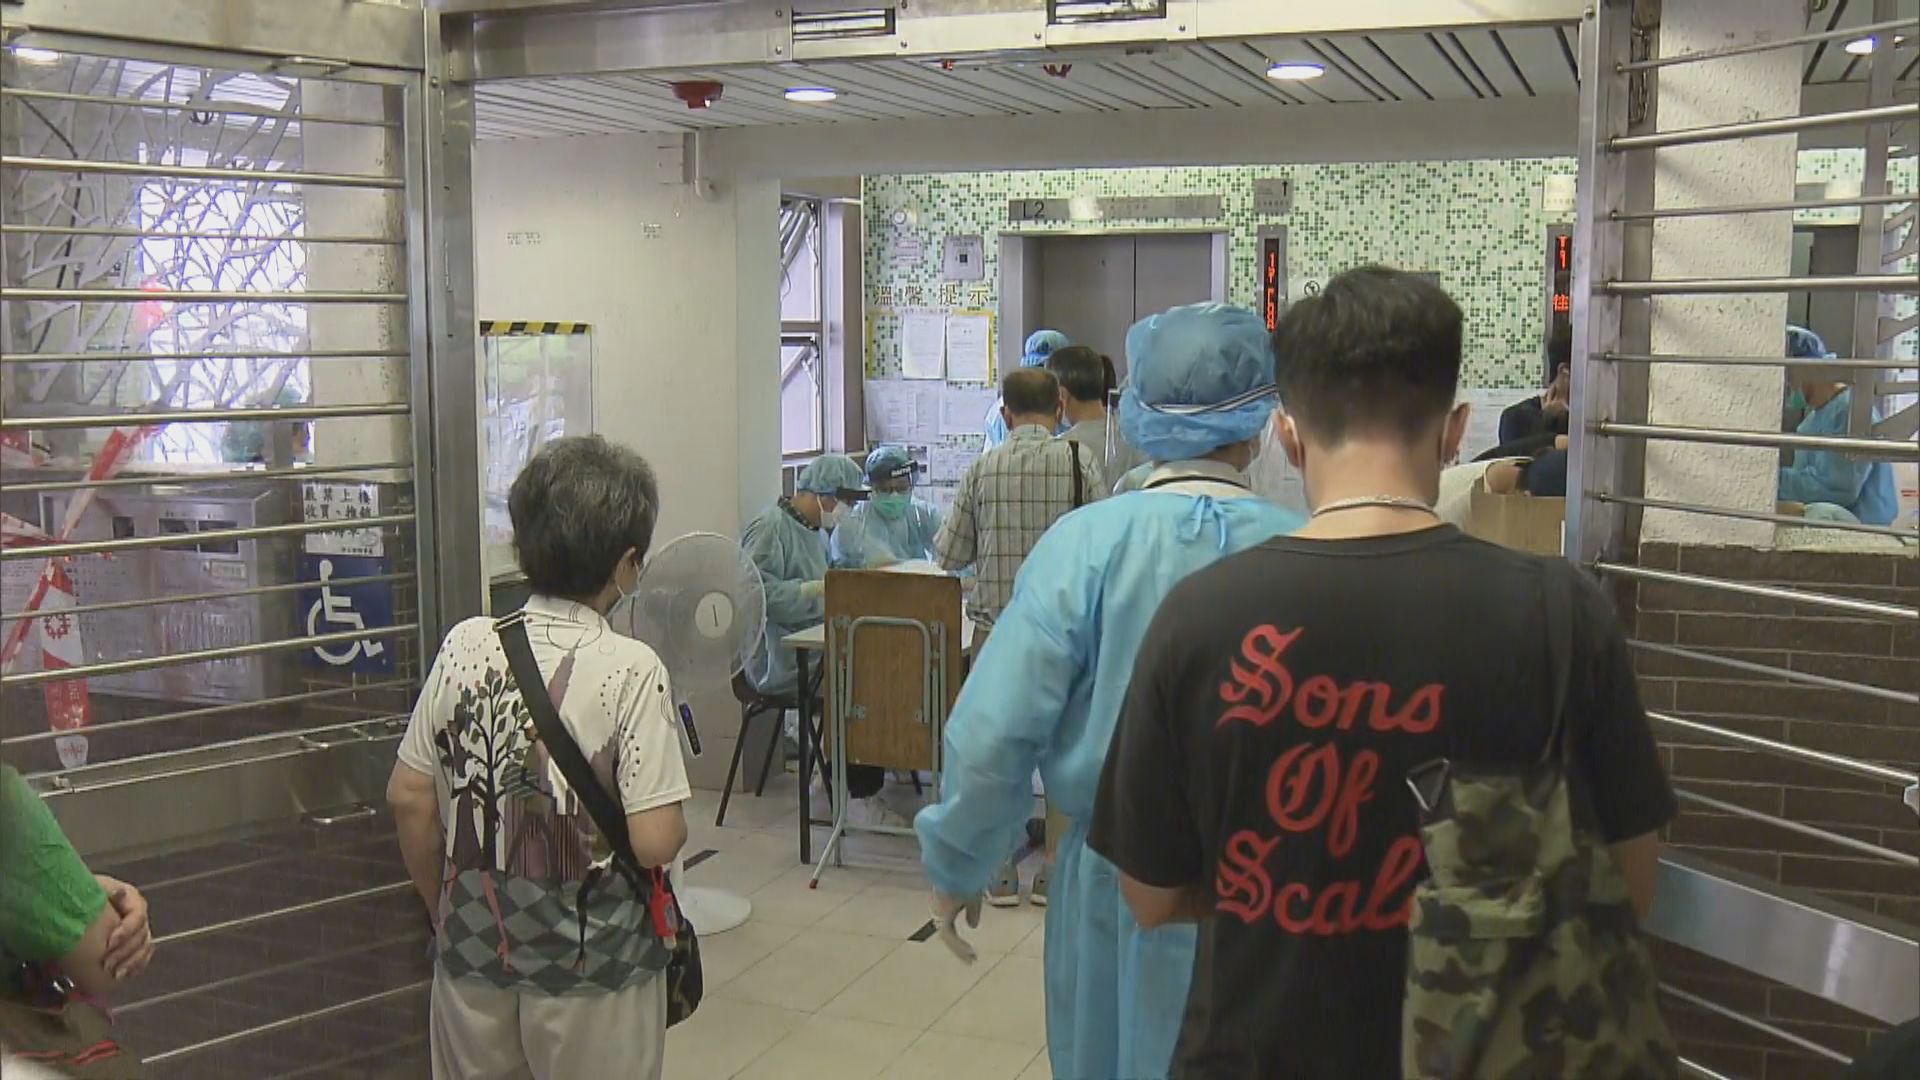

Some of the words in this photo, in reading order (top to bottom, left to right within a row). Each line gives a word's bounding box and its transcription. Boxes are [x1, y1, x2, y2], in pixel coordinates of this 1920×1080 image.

[1022, 201, 1045, 219] L2
[1215, 624, 1445, 733] Sons
[1265, 741, 1380, 858] Of
[1215, 830, 1424, 936] Scal
